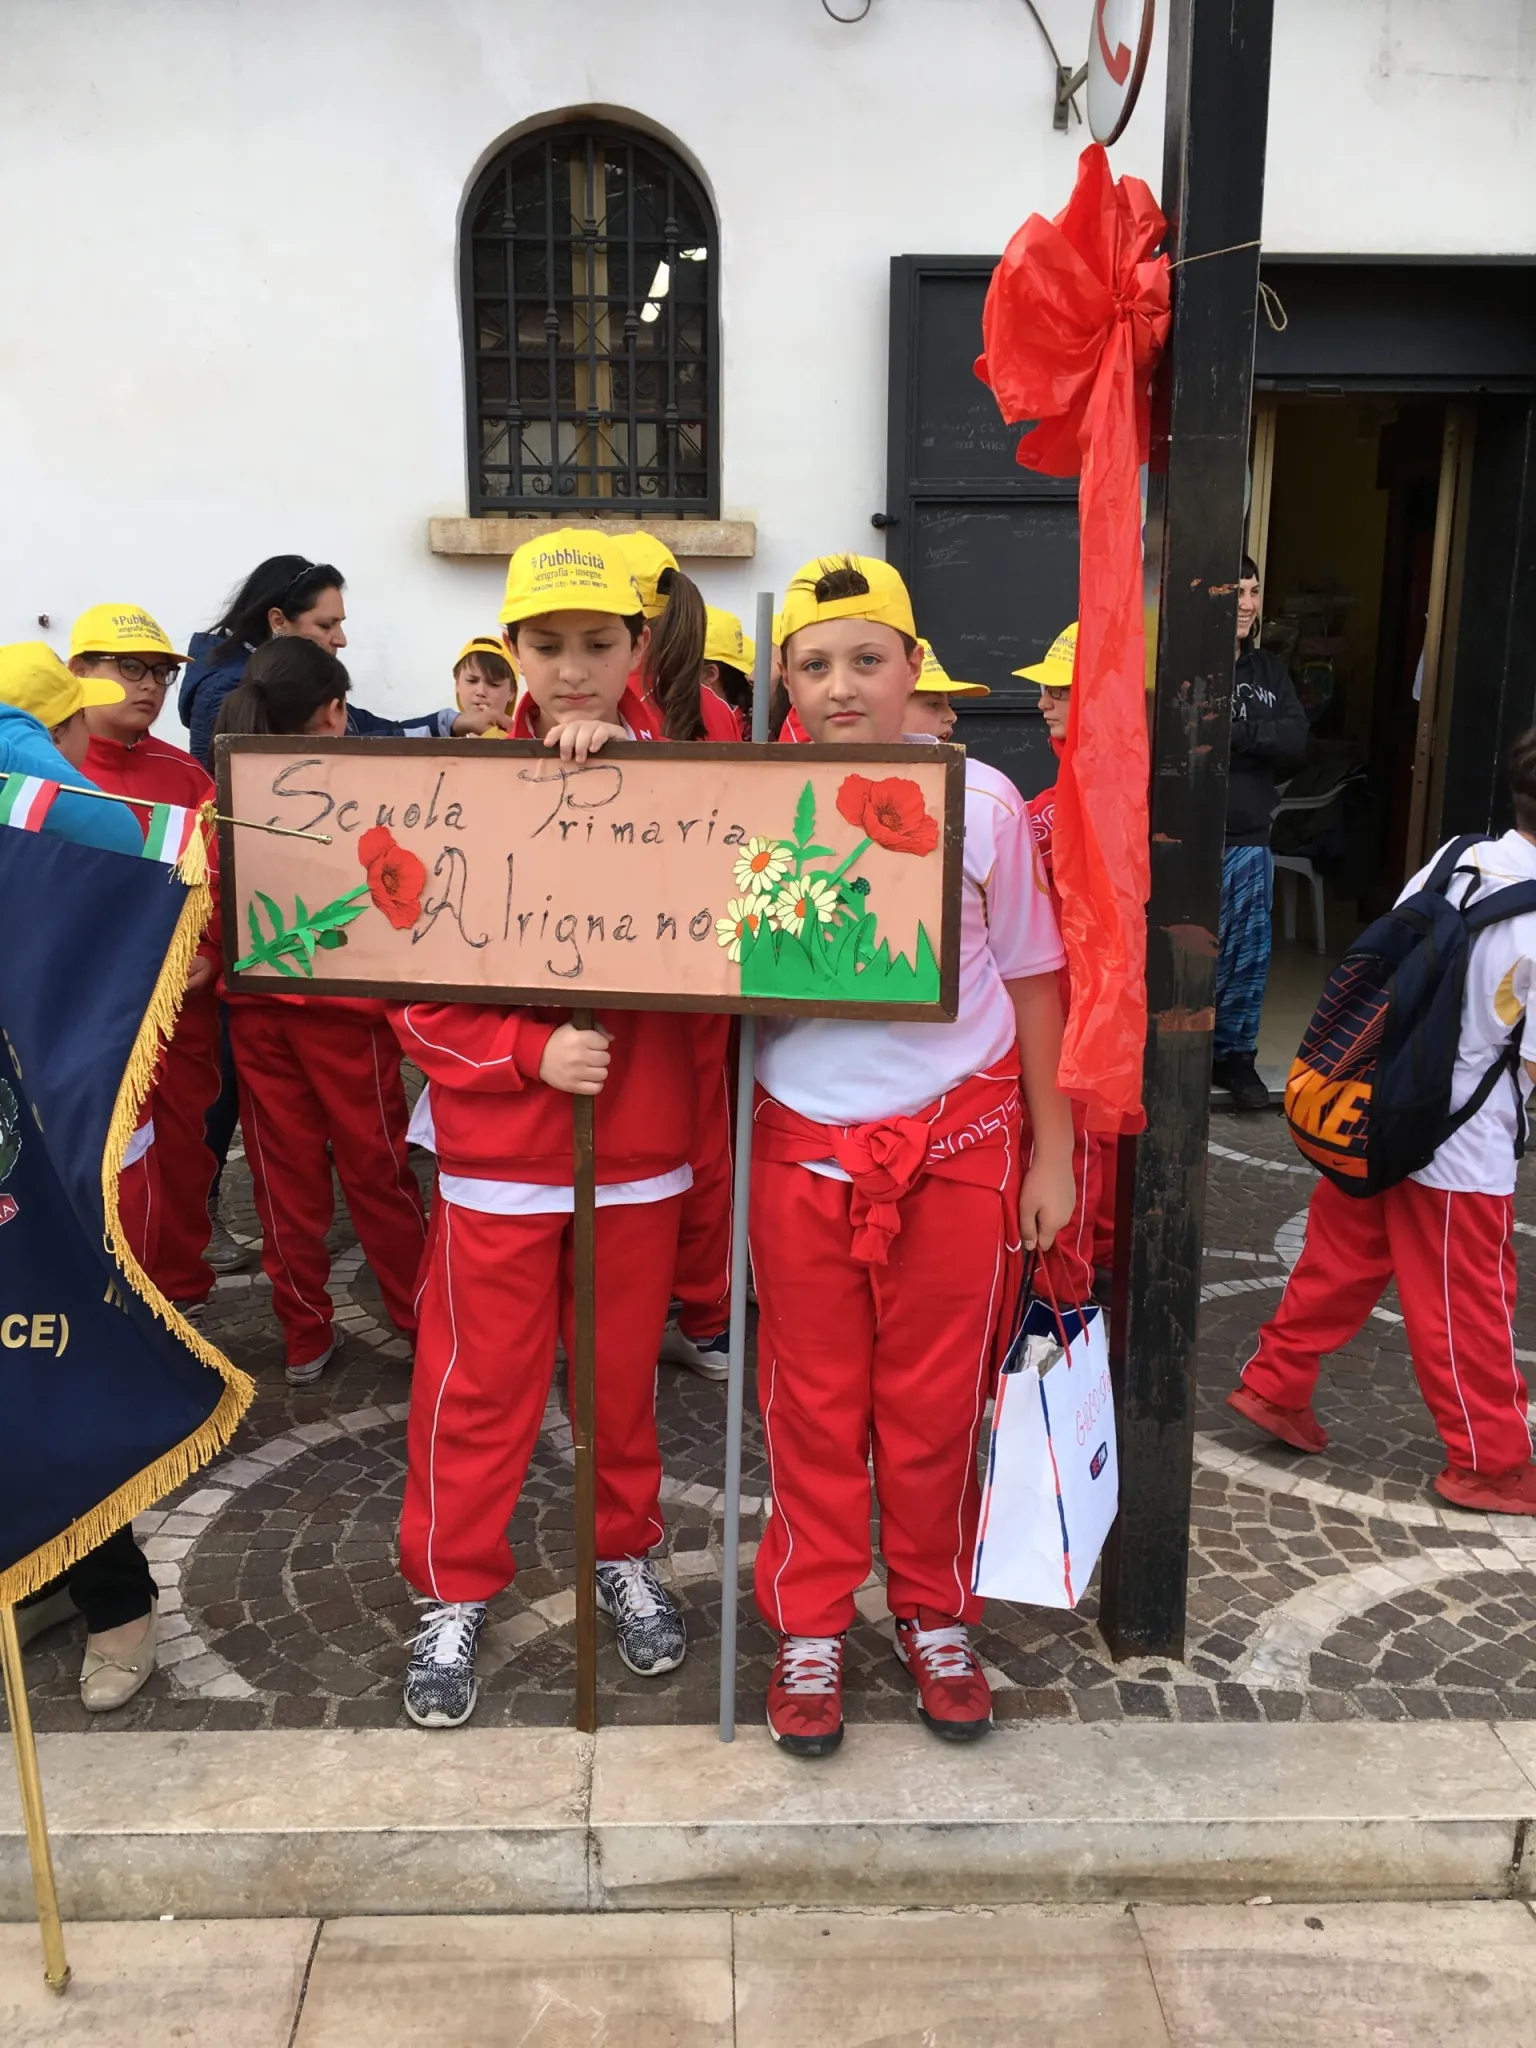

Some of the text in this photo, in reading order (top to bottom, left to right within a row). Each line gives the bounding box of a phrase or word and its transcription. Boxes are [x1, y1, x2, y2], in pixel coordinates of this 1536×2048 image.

[539, 548, 605, 570] Pubblicità
[575, 568, 602, 580] insegne
[265, 759, 749, 846] Scuola Primaria
[0, 1313, 70, 1357] CE)
